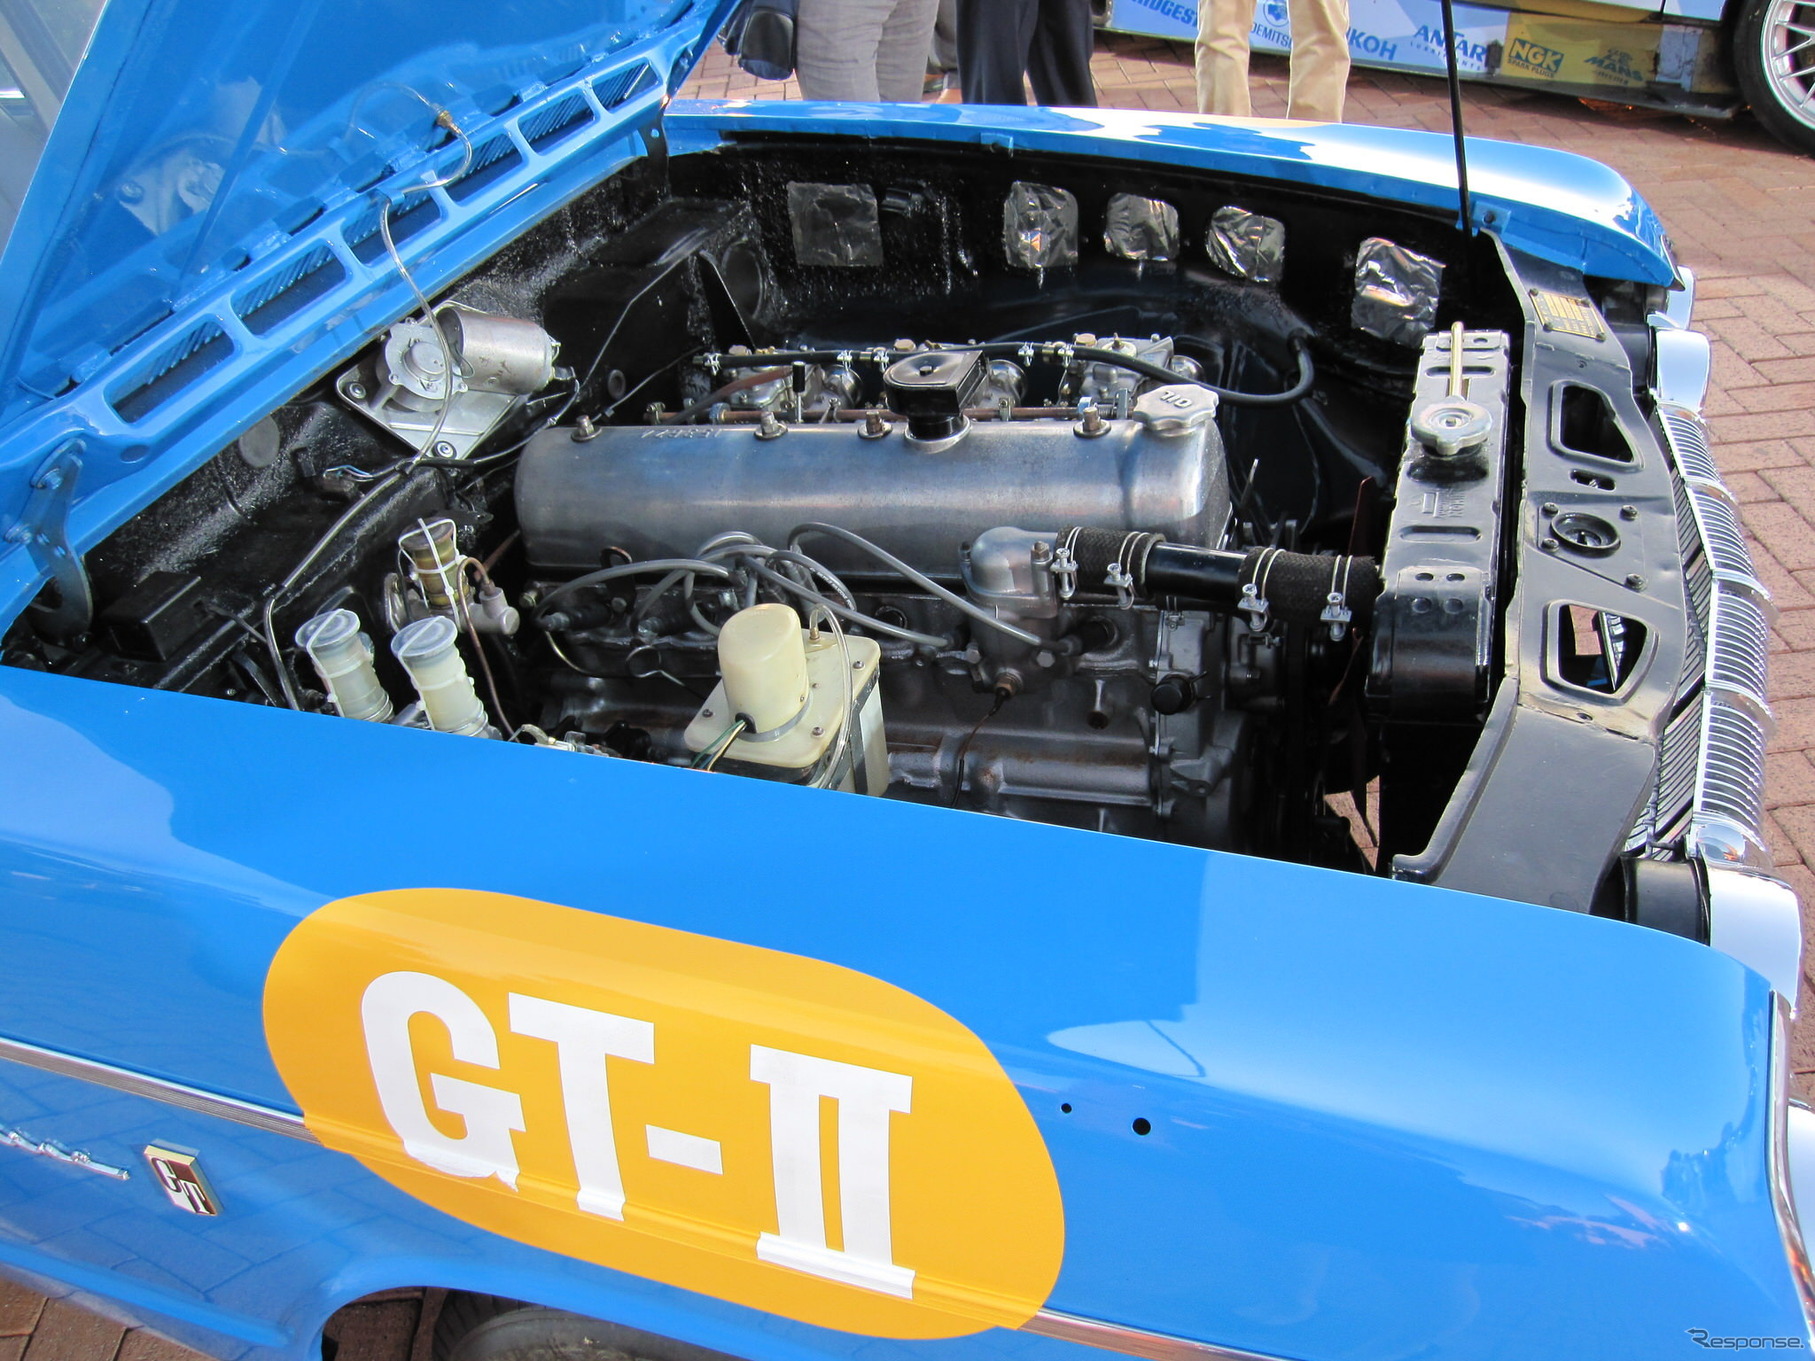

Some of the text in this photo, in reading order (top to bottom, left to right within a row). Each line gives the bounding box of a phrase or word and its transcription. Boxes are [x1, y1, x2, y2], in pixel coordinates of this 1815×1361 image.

[1509, 39, 1563, 73] NGK
[1160, 390, 1193, 409] OIL
[151, 1157, 211, 1214] GT
